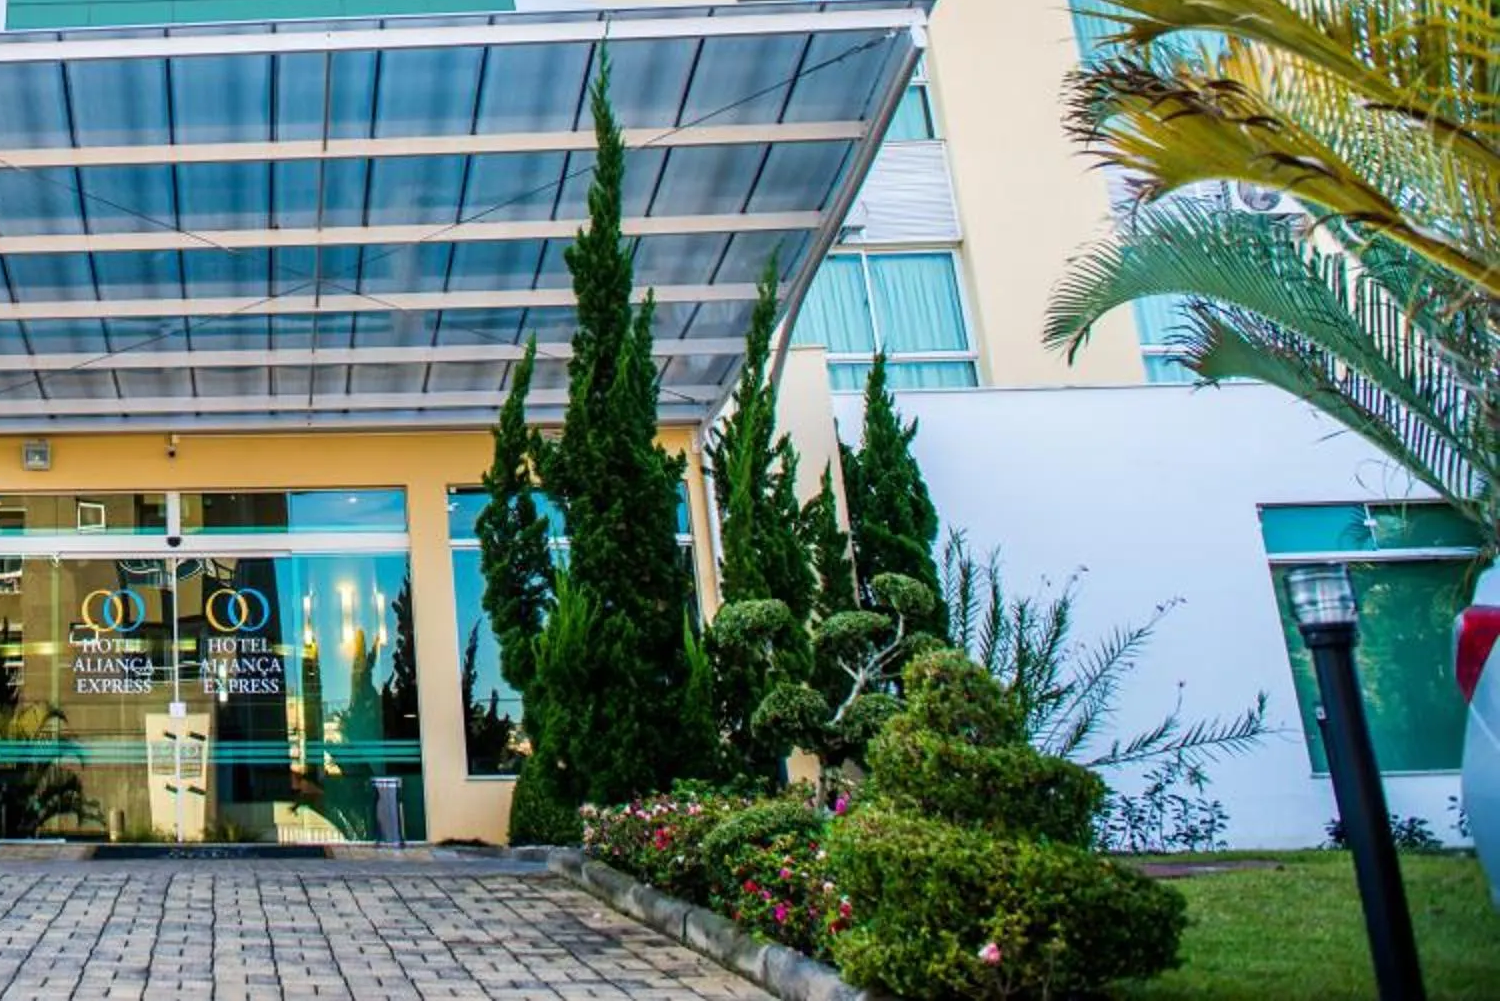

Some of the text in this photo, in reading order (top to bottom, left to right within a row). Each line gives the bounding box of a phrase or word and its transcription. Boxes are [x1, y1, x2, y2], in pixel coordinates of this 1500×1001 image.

[82, 638, 147, 654] HOTEL
[208, 638, 273, 654] HOTEL
[200, 656, 282, 678] ALIANÇA
[76, 678, 153, 694] EXPRESS
[204, 678, 280, 694] EXPRESS
